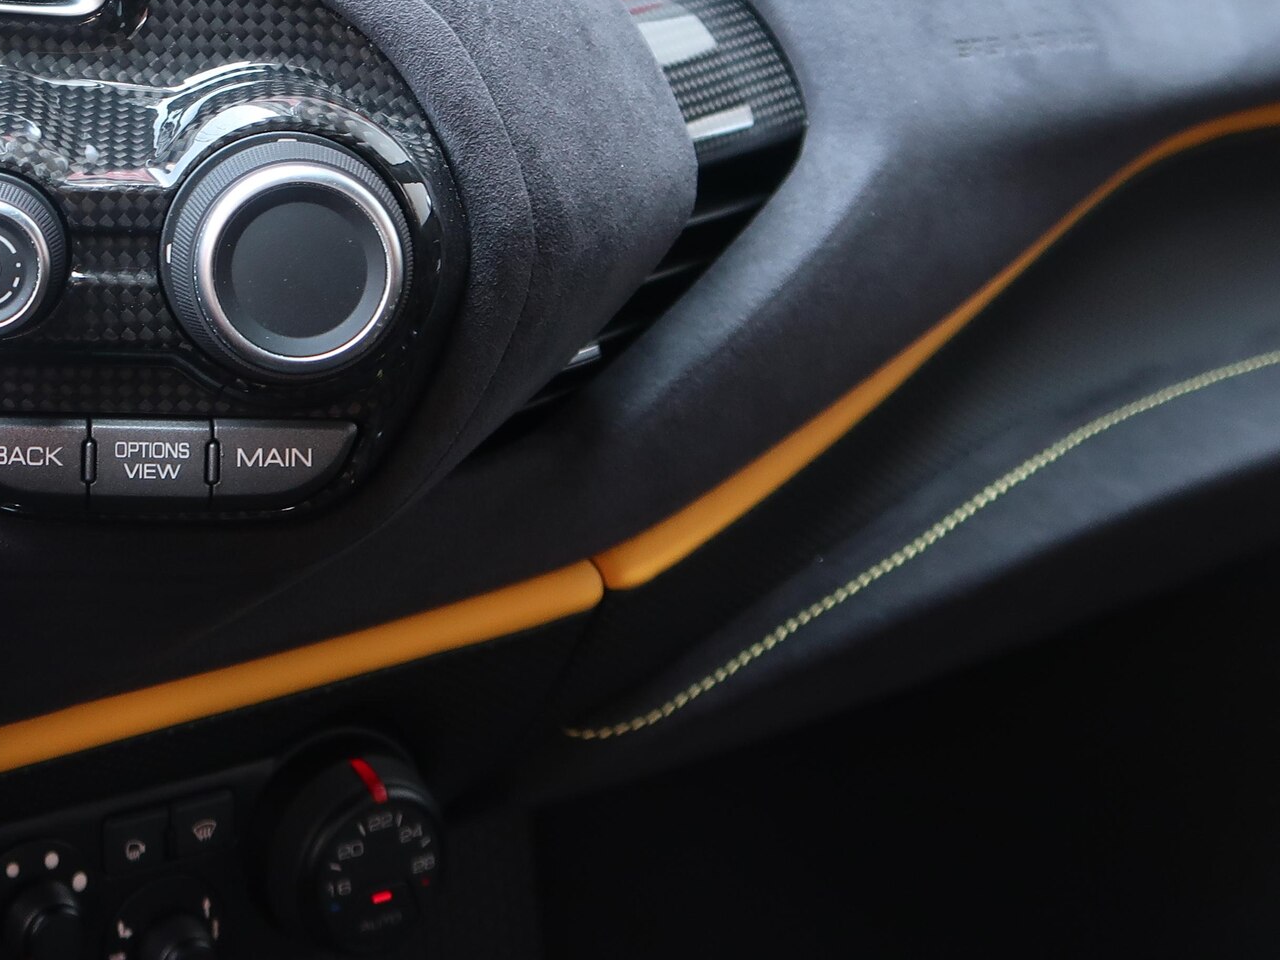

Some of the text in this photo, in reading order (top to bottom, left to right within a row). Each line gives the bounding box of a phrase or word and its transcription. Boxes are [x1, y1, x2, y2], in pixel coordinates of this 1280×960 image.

[114, 440, 191, 461] OPTIONS
[236, 446, 313, 469] MAIN
[123, 462, 182, 481] VIEW
[368, 811, 394, 833] 22
[399, 823, 423, 844] 24
[336, 840, 364, 861] 20
